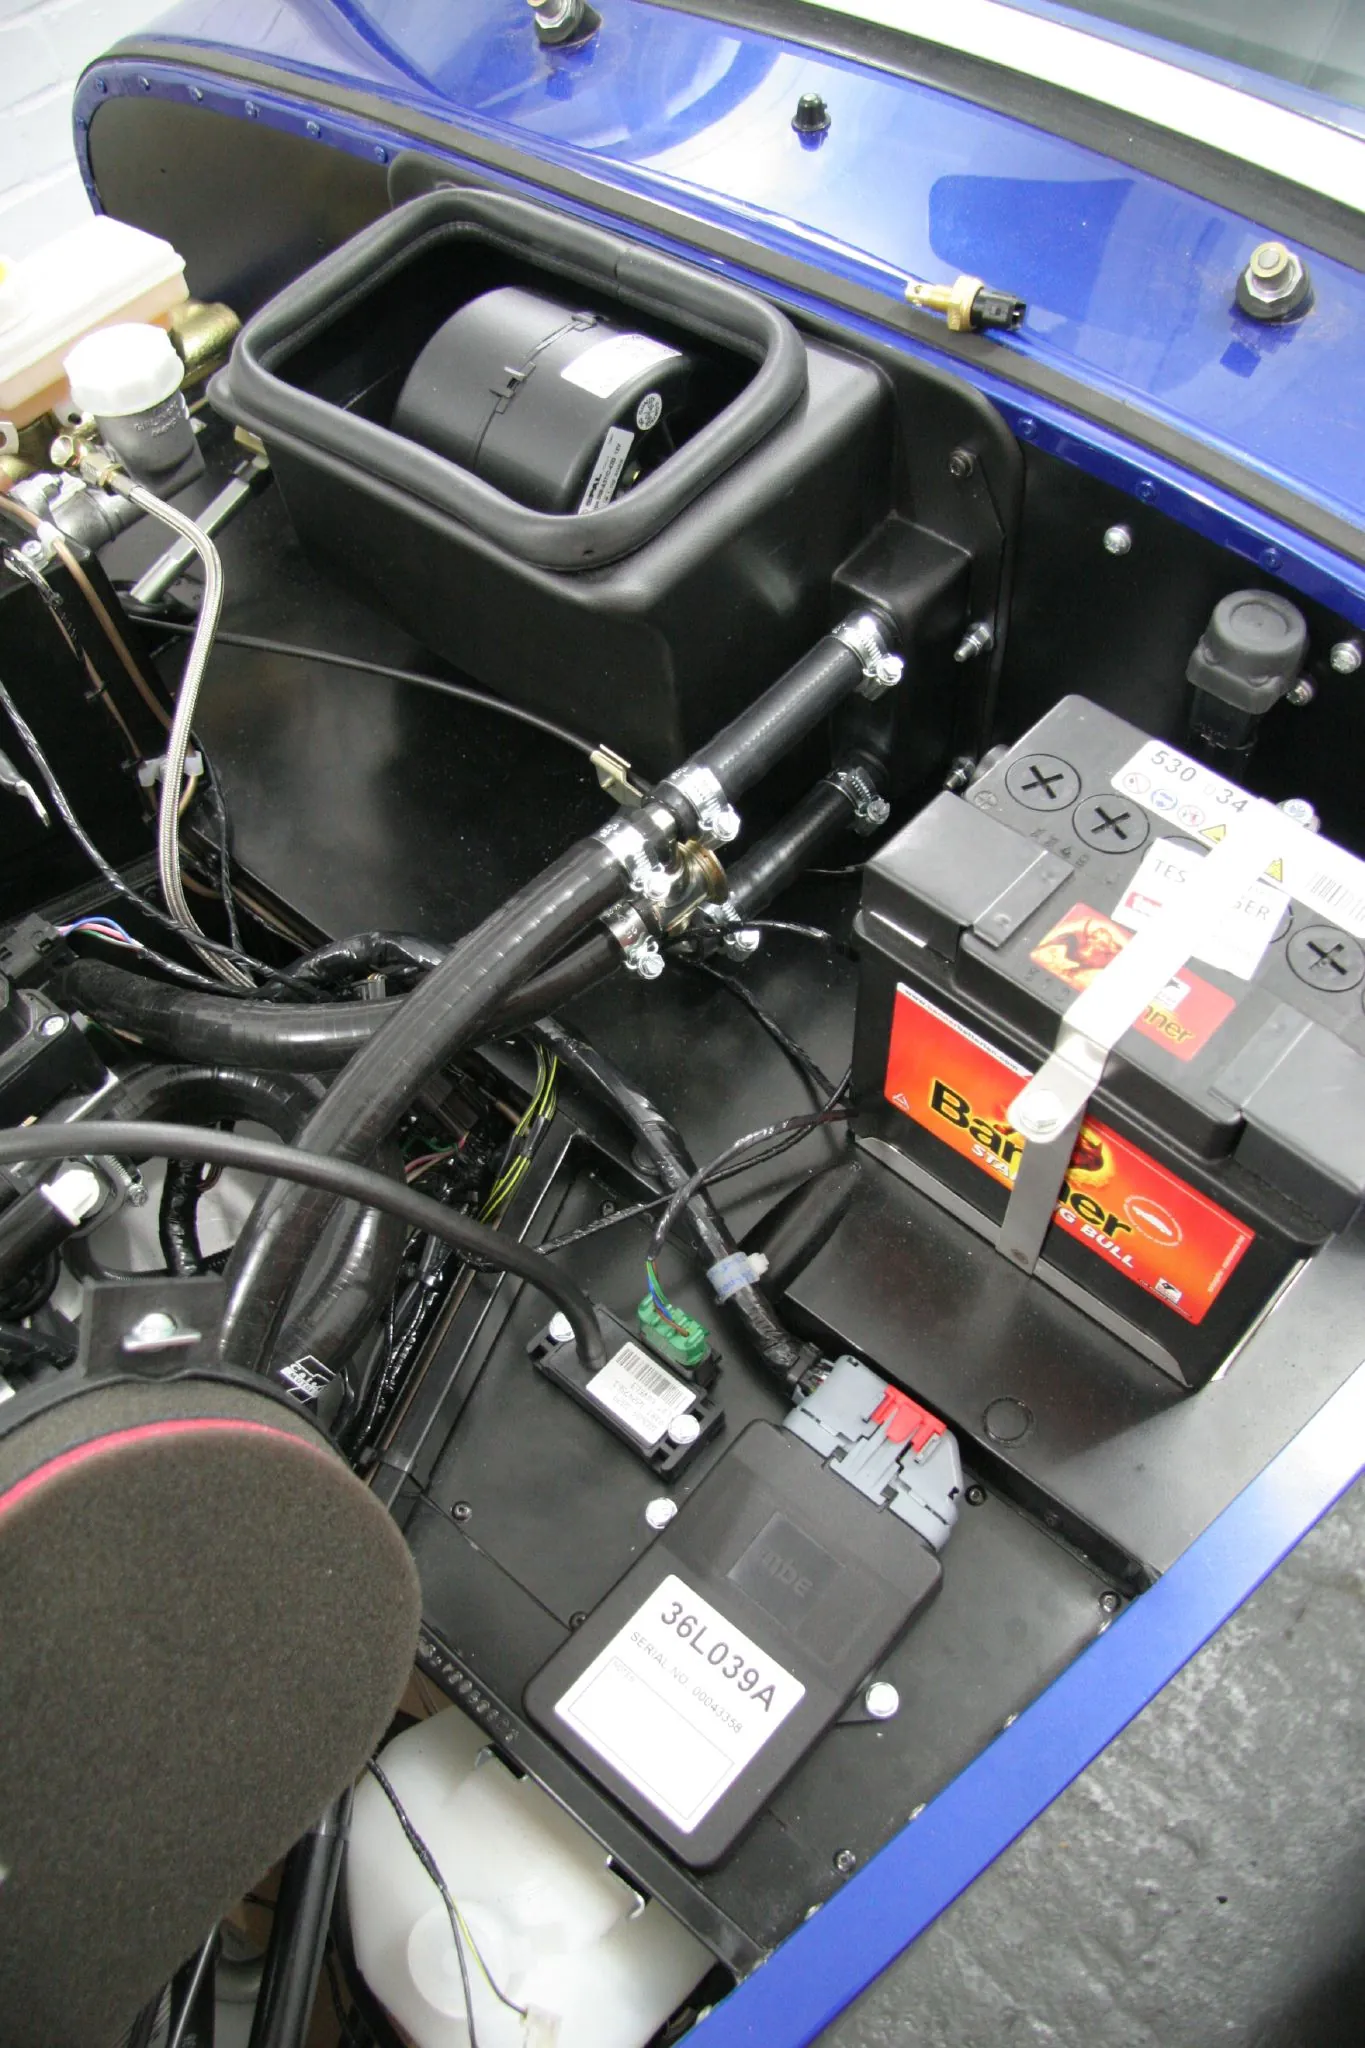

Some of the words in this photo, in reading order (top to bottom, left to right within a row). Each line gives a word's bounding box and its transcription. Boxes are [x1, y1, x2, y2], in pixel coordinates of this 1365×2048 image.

[584, 472, 602, 506] SPAL
[1151, 750, 1196, 782] 530
[1080, 1224, 1135, 1270] BULL
[629, 1631, 669, 1670] SERIAL
[668, 1665, 690, 1688] NO.
[660, 1600, 778, 1713] 36L039A
